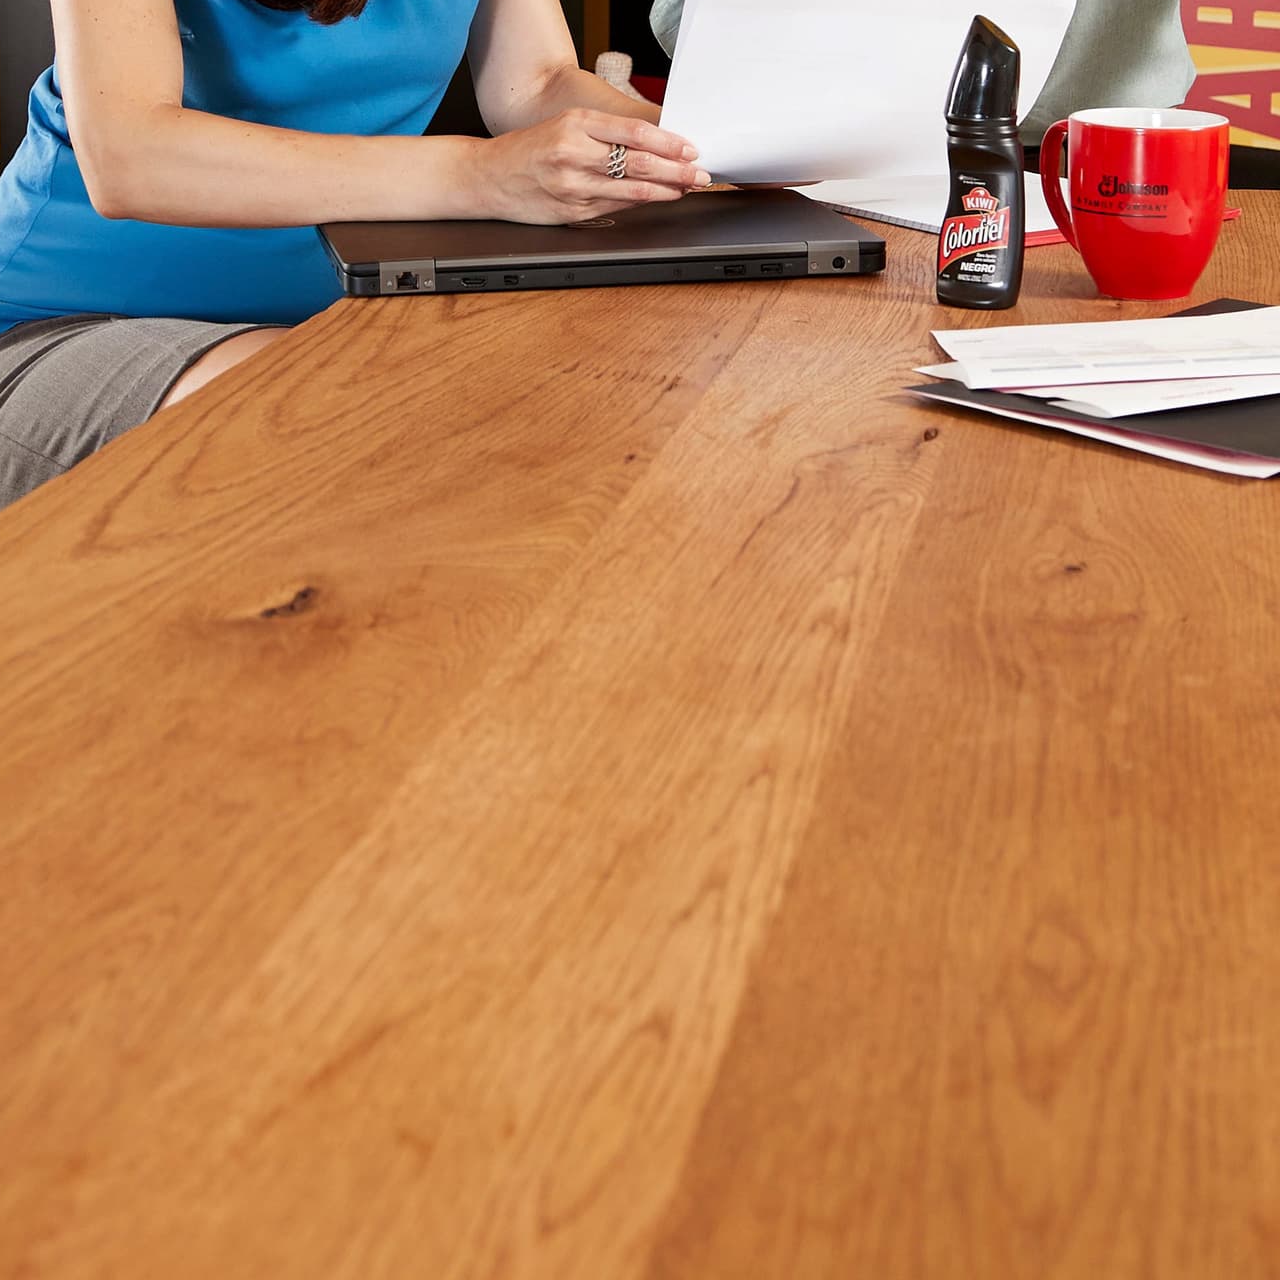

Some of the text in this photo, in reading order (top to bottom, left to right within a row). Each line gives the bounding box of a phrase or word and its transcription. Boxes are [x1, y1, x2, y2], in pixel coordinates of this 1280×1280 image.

[966, 197, 994, 210] KIWI
[943, 214, 1005, 258] Colorfiel
[959, 261, 996, 273] NEGRO
